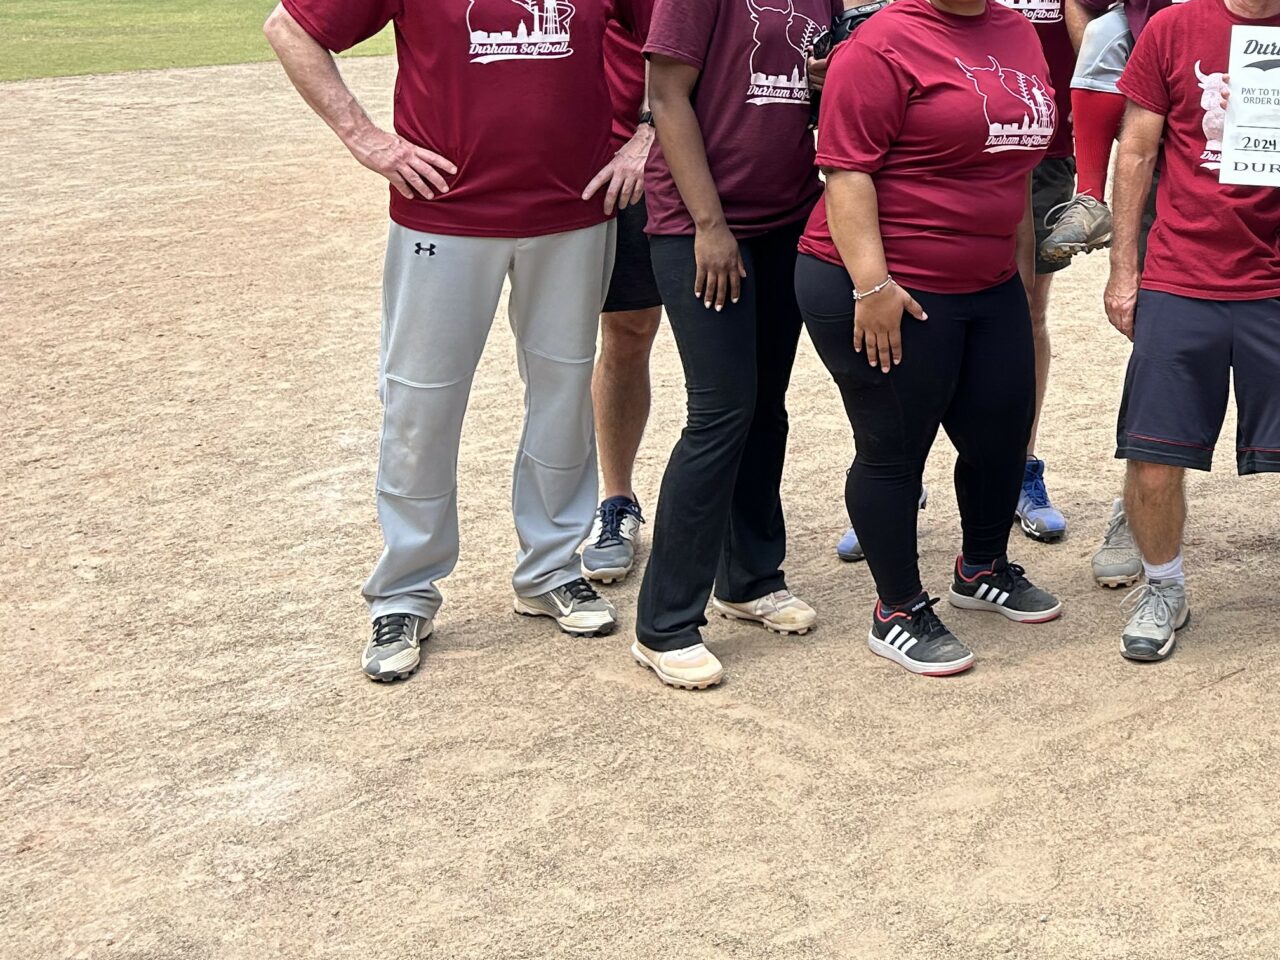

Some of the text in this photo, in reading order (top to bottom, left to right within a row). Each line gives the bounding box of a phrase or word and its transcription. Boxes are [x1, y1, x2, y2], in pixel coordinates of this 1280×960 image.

[469, 41, 570, 56] Durham Softball
[746, 85, 790, 98] Durham
[1241, 87, 1256, 96] PAY
[1258, 88, 1270, 96] TO
[1243, 96, 1272, 105] ORDER
[1241, 136, 1277, 150] 2024
